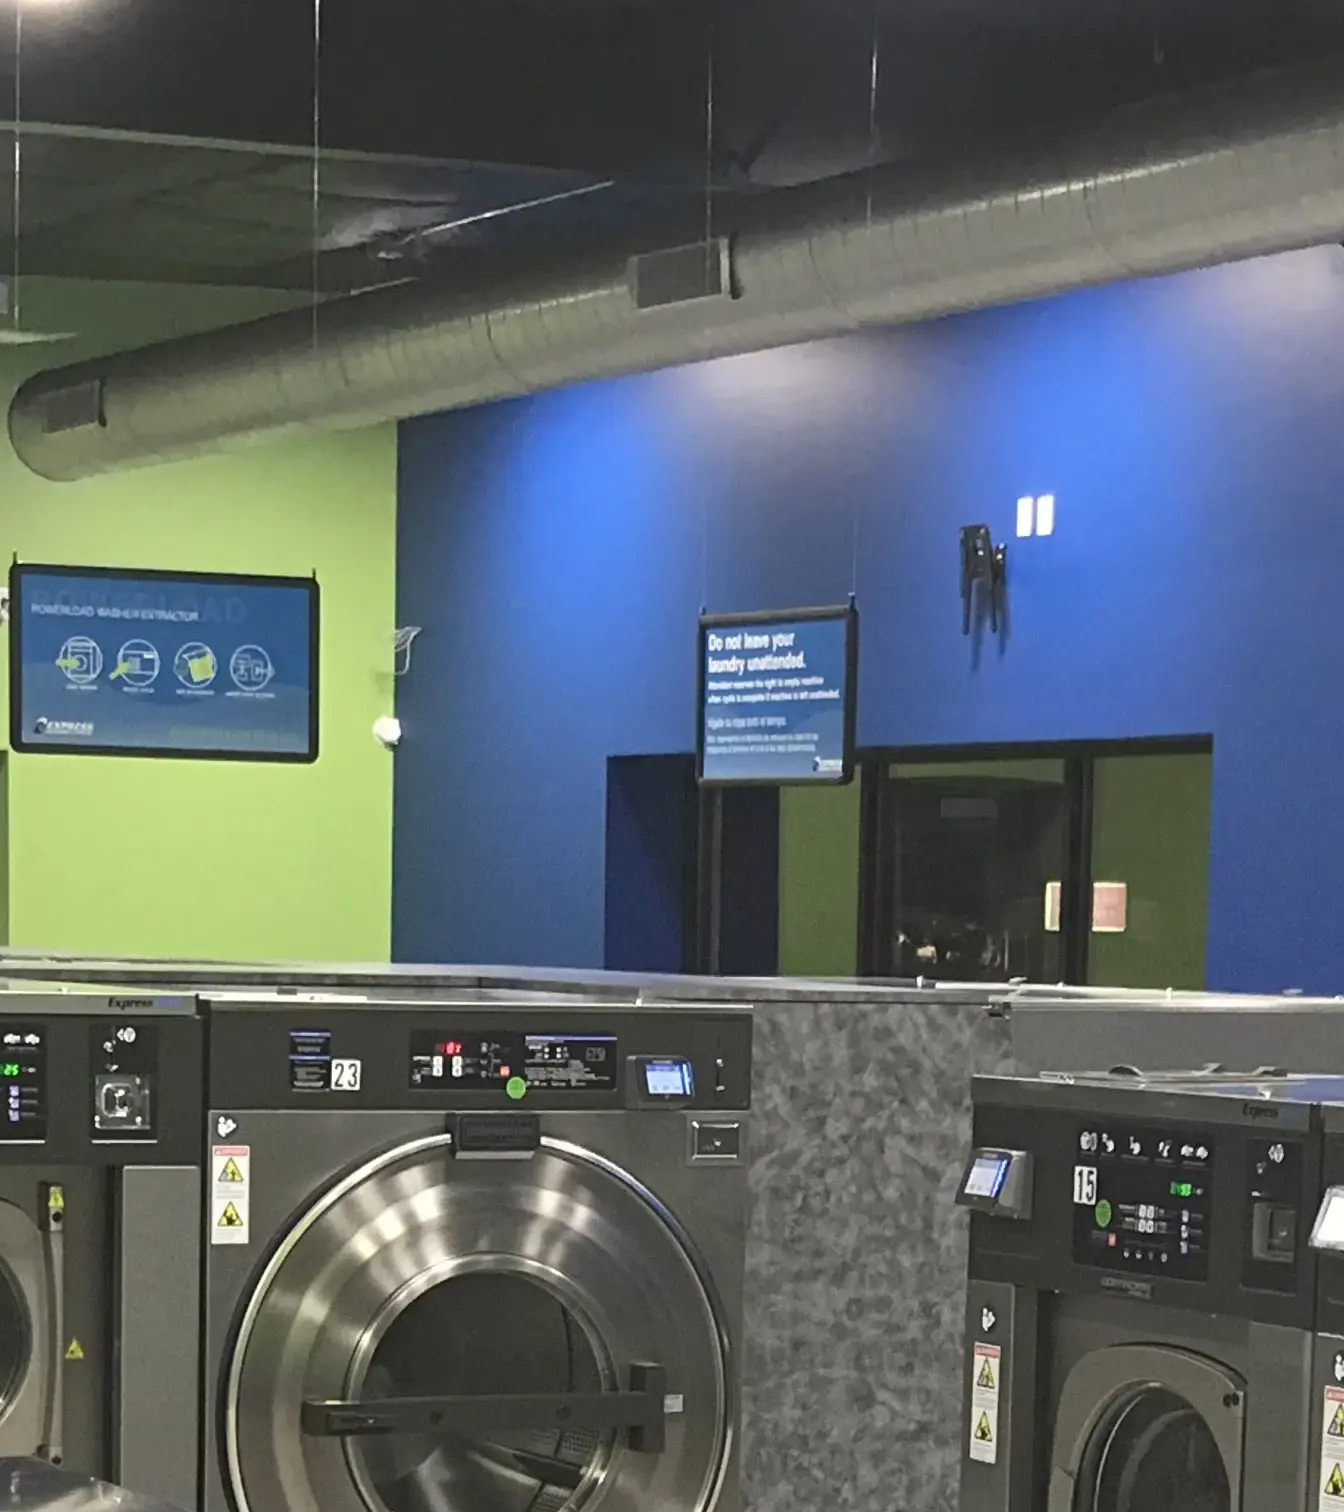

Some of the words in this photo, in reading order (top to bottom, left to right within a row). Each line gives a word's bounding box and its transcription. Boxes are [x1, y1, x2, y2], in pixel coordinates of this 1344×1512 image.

[708, 634, 723, 651] Do
[725, 634, 742, 650] not
[772, 632, 795, 652] your
[708, 655, 745, 676] laundry
[334, 1062, 358, 1088] 23
[1078, 1169, 1095, 1203] 15
